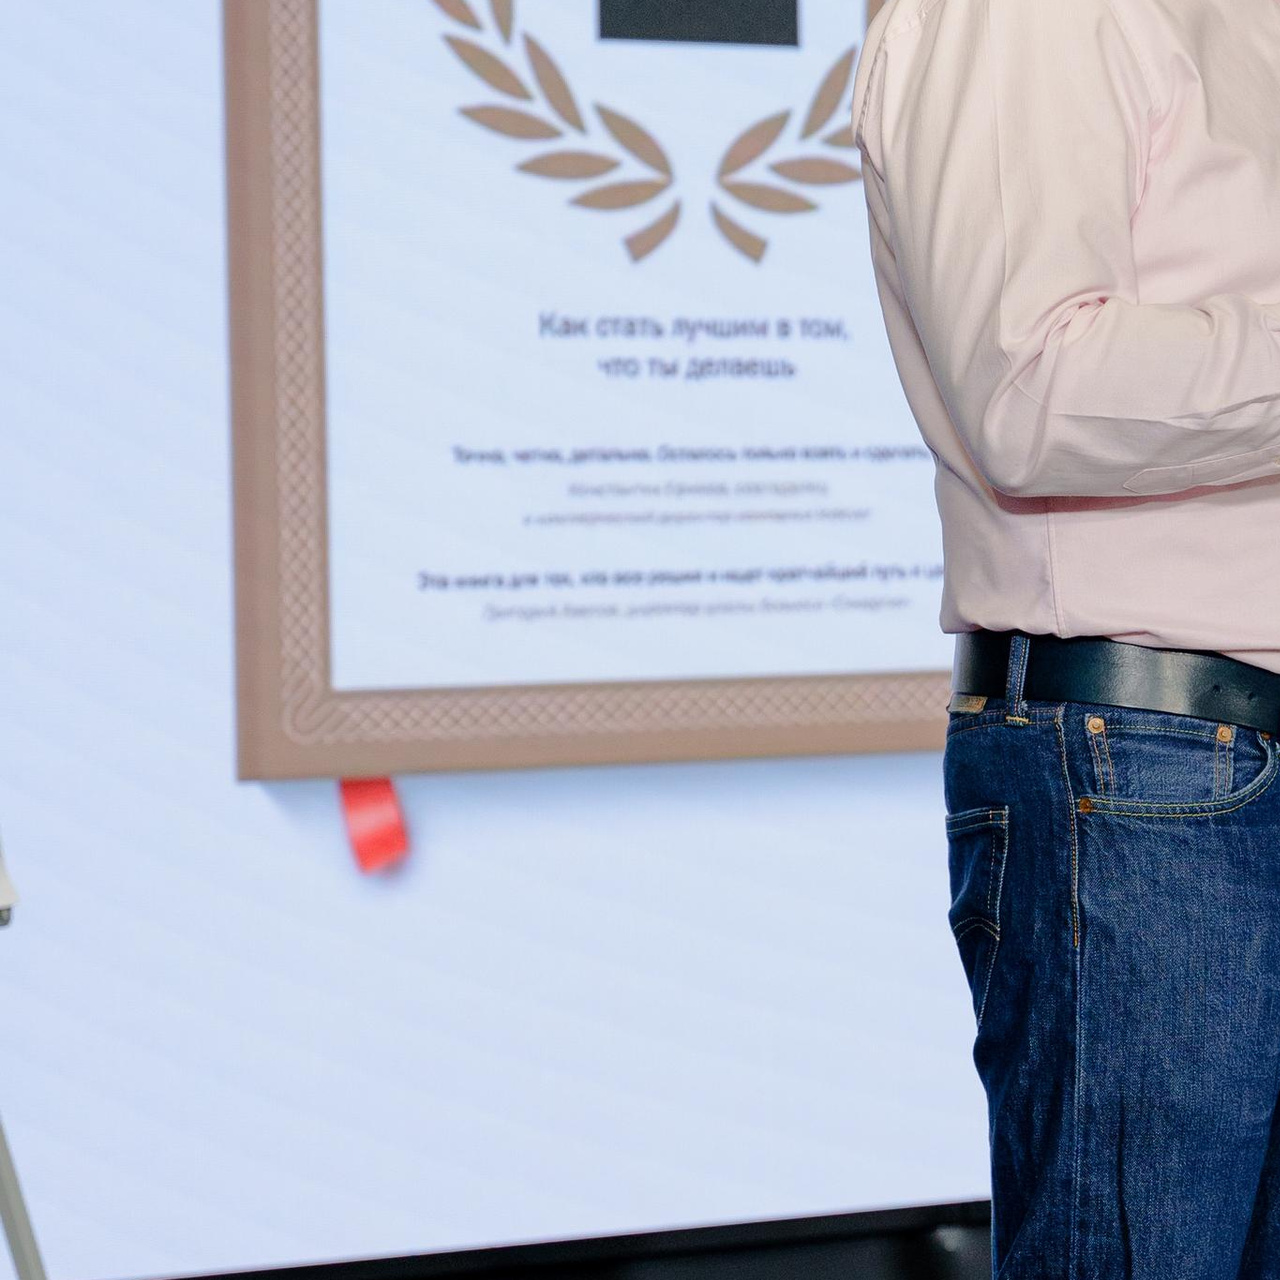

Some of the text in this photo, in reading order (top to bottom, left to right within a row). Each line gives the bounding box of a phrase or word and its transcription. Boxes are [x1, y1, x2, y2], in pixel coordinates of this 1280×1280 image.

[539, 312, 849, 344] Как стать лучшим в том,
[597, 356, 796, 380] что ты делаешь
